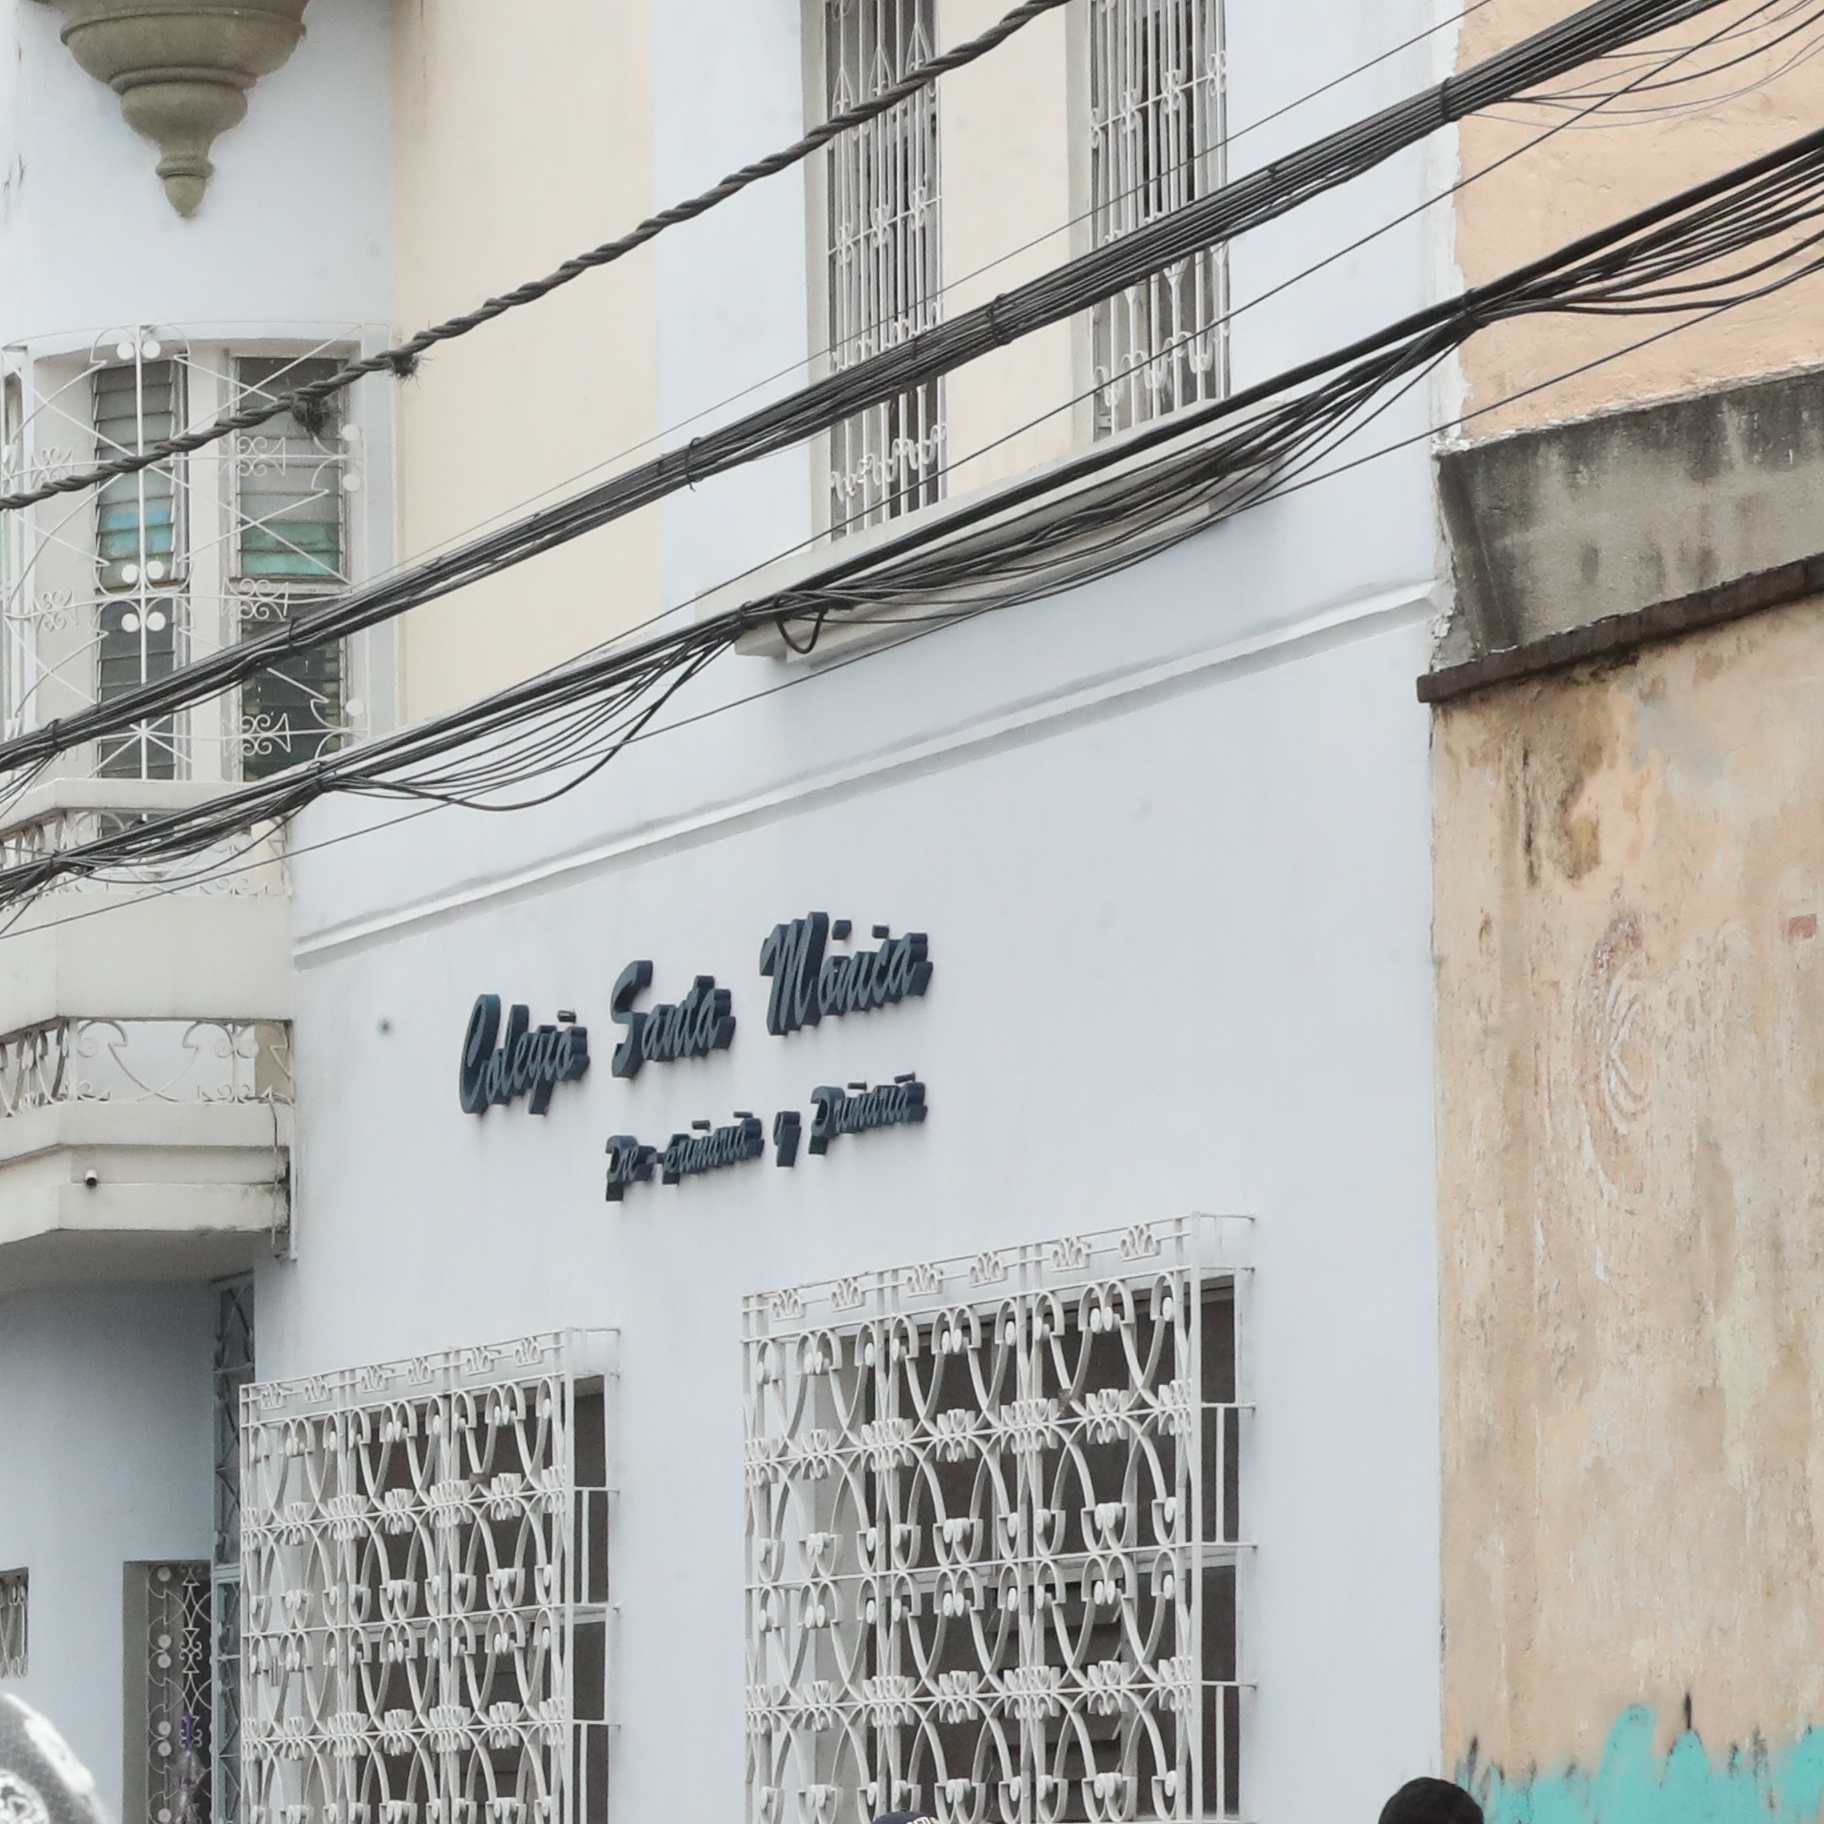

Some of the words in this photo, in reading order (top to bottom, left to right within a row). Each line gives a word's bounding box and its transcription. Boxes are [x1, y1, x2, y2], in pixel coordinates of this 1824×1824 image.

[459, 994, 590, 1115] Colegio
[610, 960, 736, 1078] Santa
[760, 911, 933, 1035] Mónica
